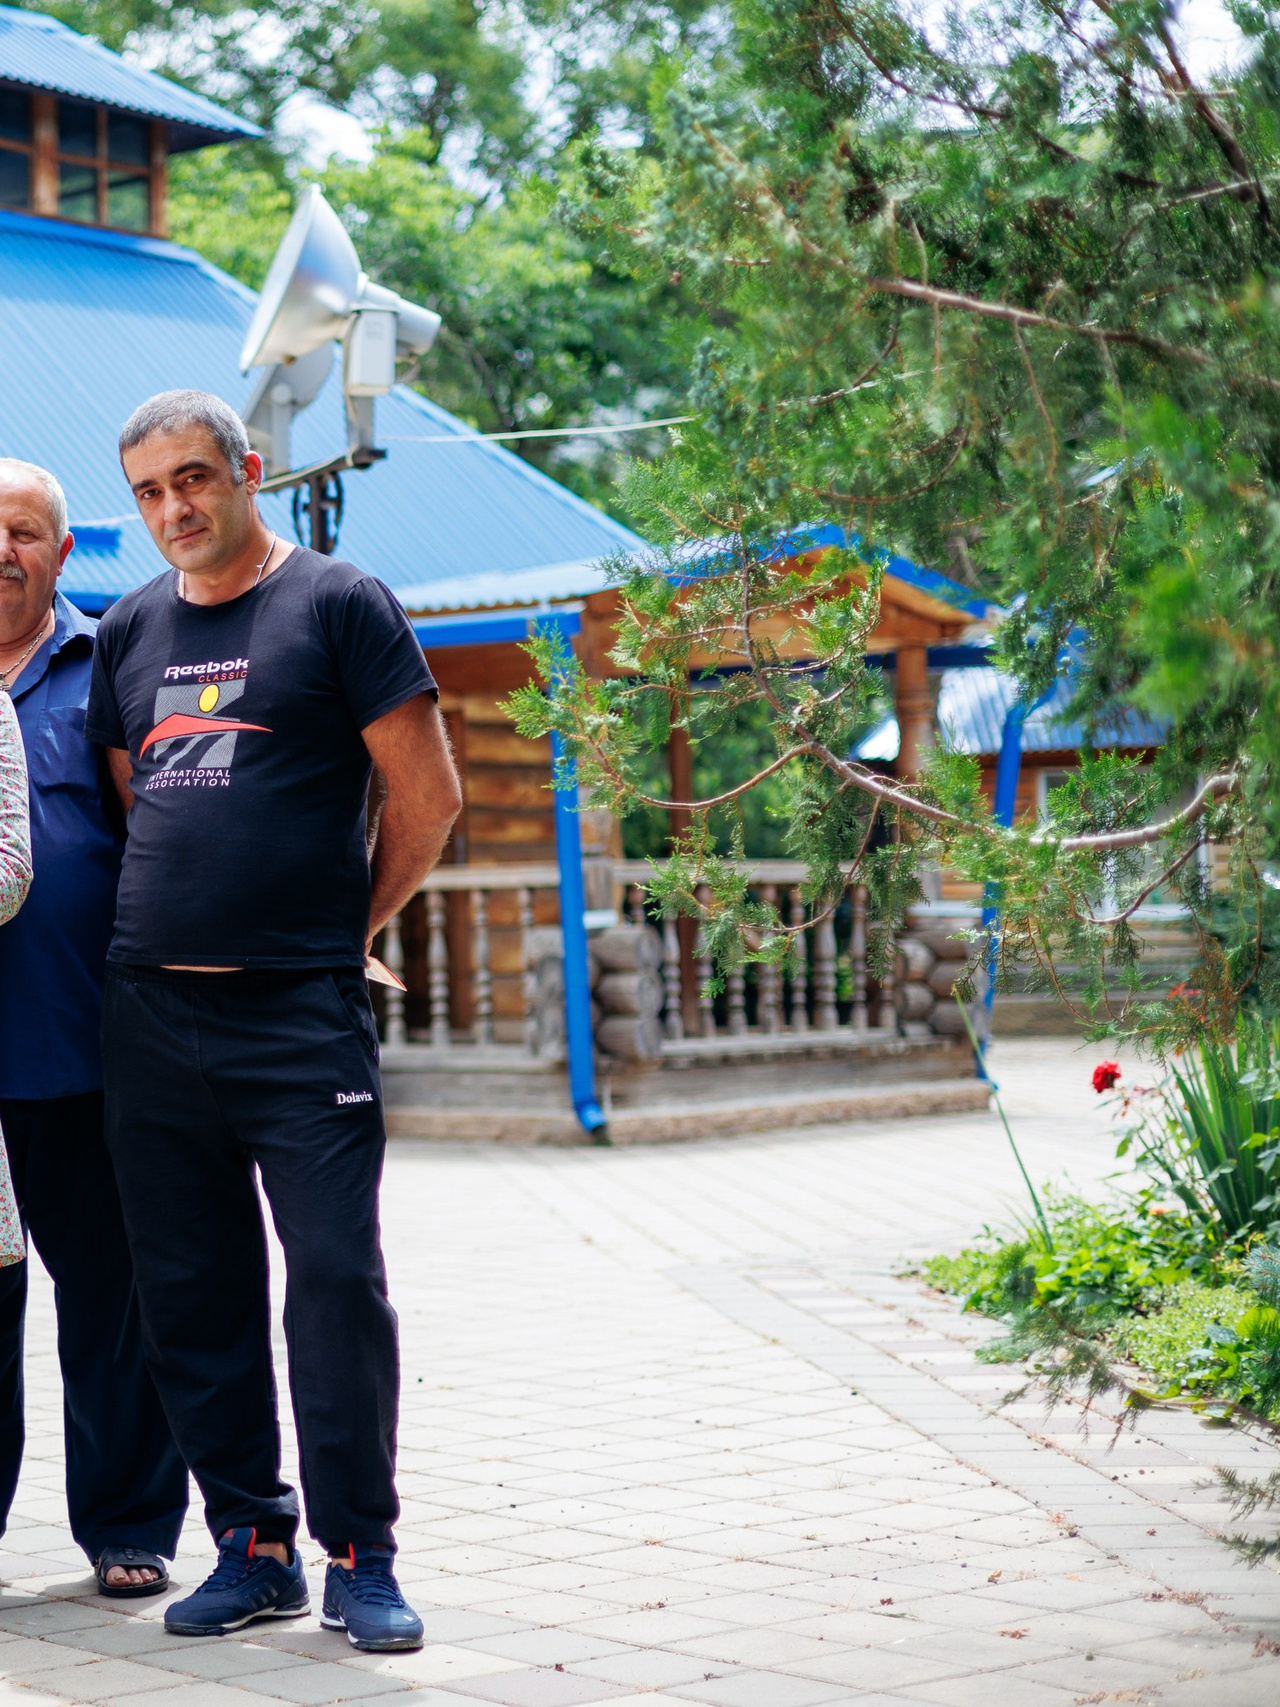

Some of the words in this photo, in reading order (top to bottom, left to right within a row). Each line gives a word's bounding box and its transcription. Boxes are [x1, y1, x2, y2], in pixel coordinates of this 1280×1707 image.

[164, 658, 250, 680] Reebok
[198, 670, 248, 683] CLASSIC
[148, 769, 231, 783] INTERNATIONAL
[145, 778, 231, 791] ASSOCIATION
[336, 1091, 374, 1105] Dolavix
